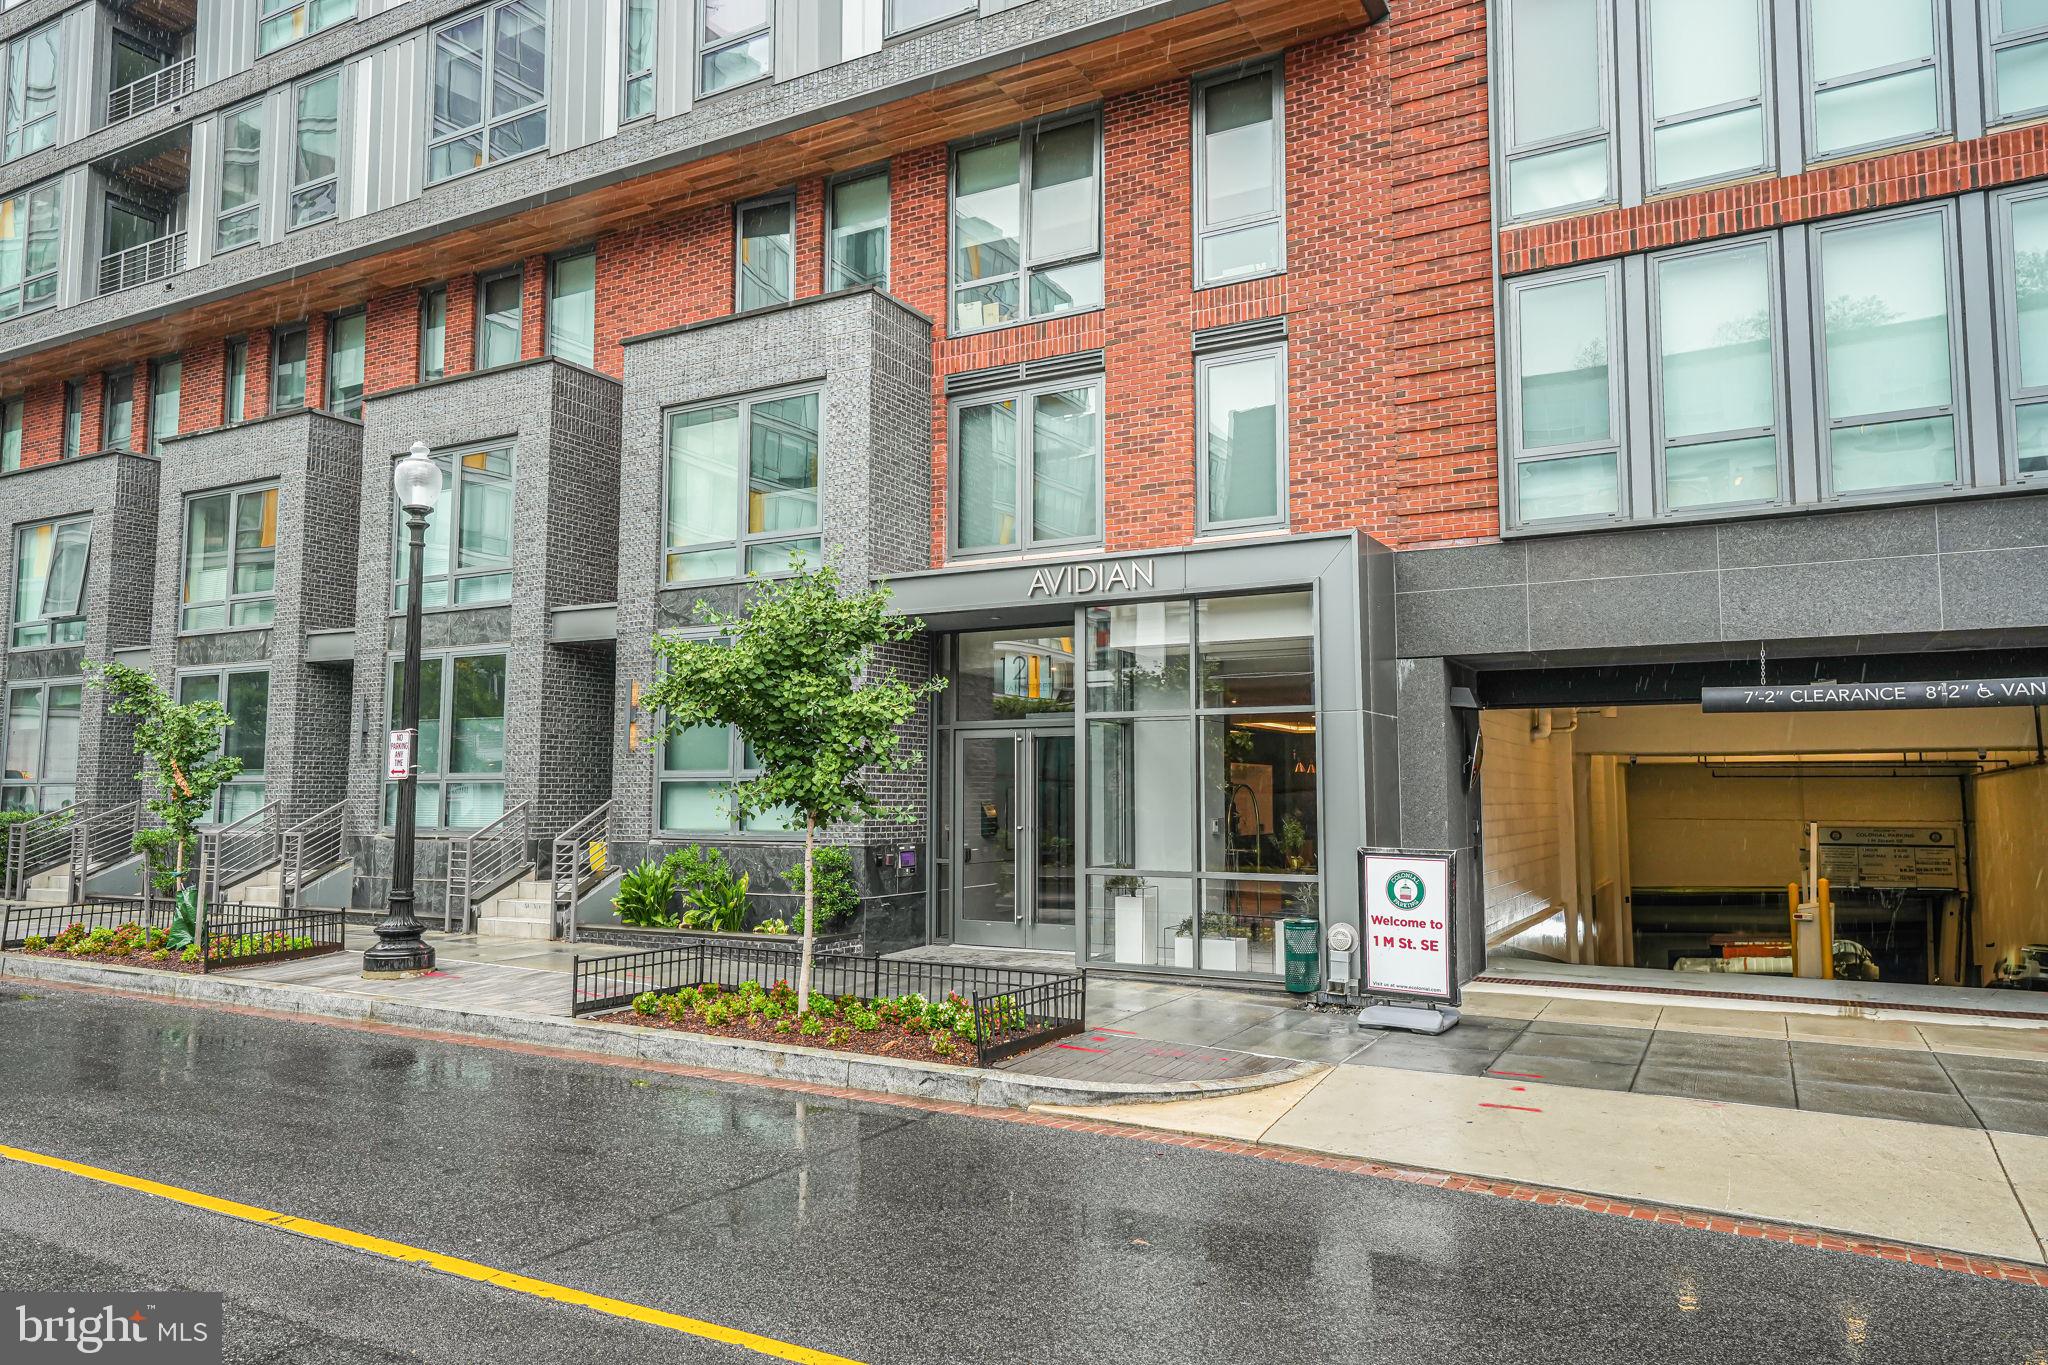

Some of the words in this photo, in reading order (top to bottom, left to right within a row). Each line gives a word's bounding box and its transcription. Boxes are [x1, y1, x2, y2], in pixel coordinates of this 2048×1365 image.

[1027, 559, 1155, 597] AVIDIAN
[1000, 655, 1051, 681] 1211
[1790, 686, 1906, 703] CLEARANCE
[2000, 681, 2046, 697] VAN
[391, 742, 408, 750] PARKING
[394, 759, 404, 767] TIME
[1391, 872, 1420, 884] COLONIAL
[1393, 898, 1419, 909] PARKING
[1371, 915, 1427, 929] Welcome
[1430, 919, 1444, 930] to
[1374, 935, 1379, 947] 1
[1383, 936, 1395, 948] M
[1398, 938, 1417, 950] St.
[1420, 939, 1439, 952] SE
